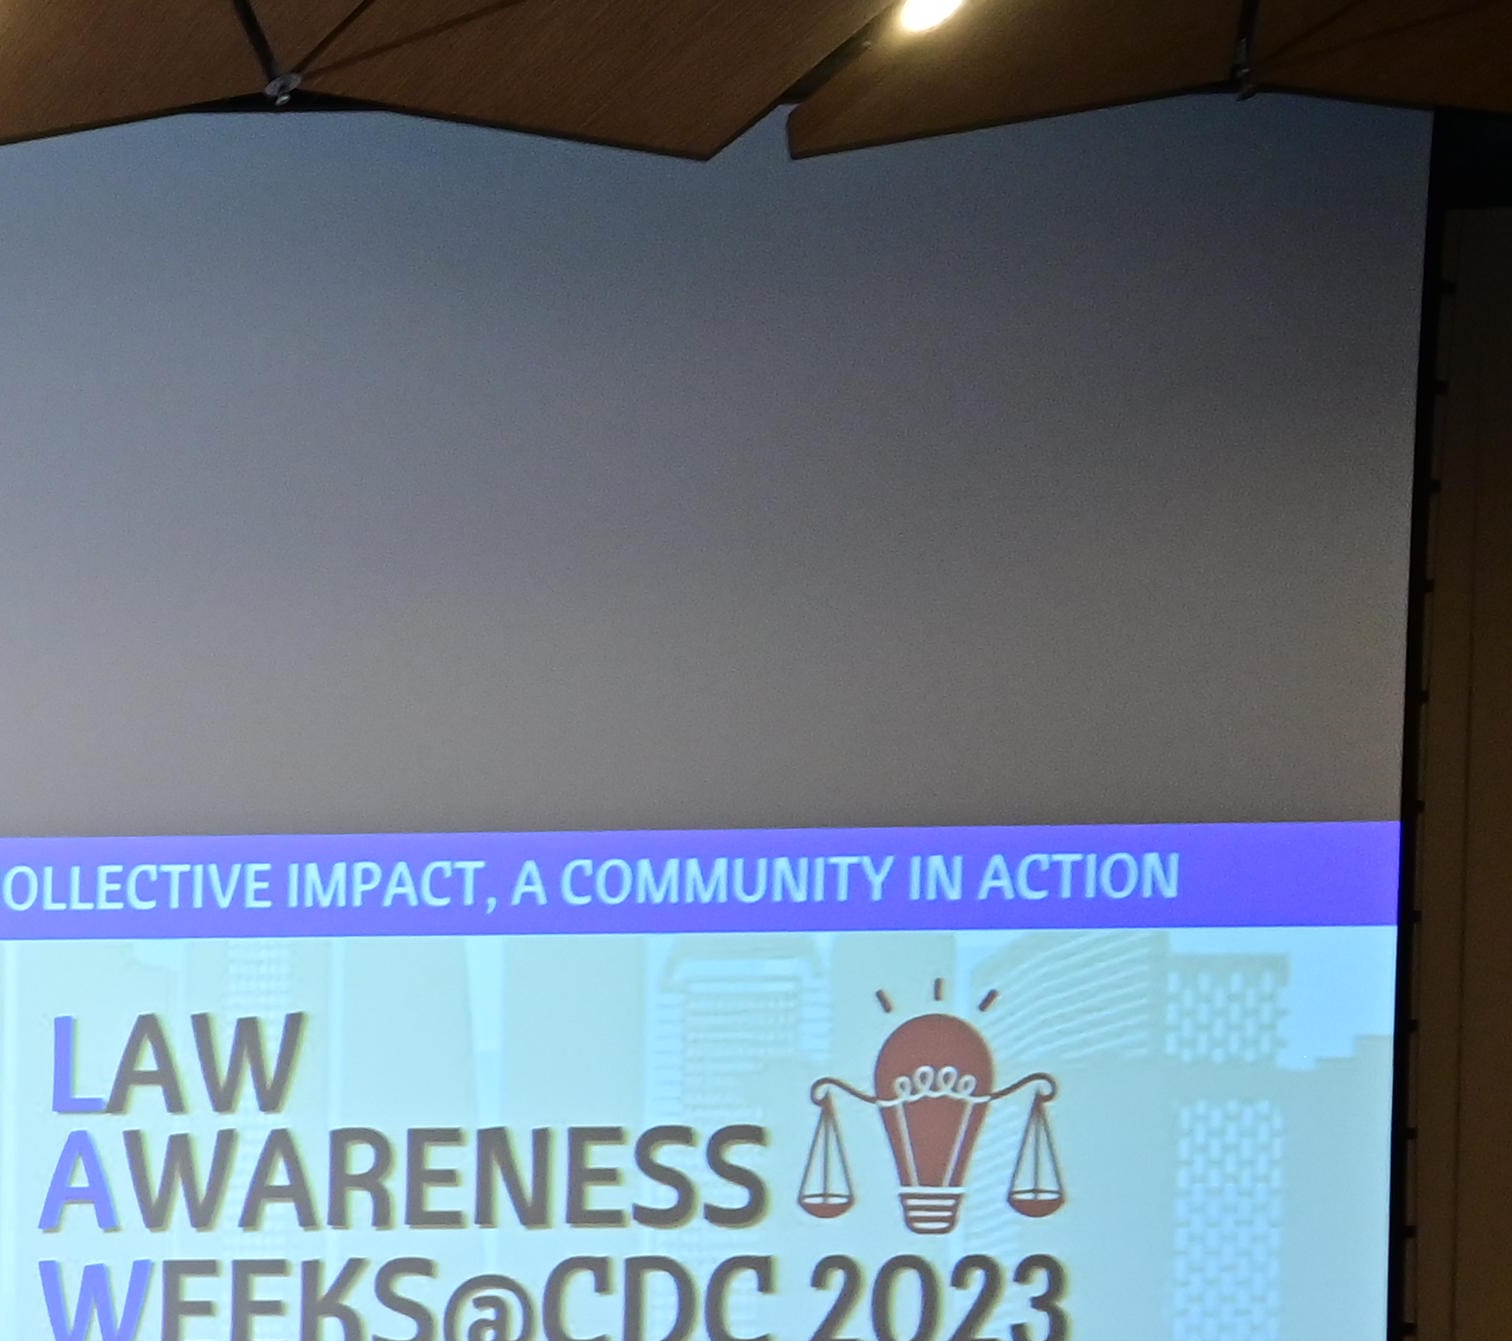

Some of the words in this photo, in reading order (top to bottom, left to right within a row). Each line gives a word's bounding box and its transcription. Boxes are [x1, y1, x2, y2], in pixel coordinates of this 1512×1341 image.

[288, 860, 497, 914] IMPACT,
[511, 859, 548, 905] A
[562, 855, 894, 904] COMMUNITY
[909, 855, 964, 900] IN
[978, 853, 1180, 900] ACTION
[50, 1010, 309, 1115] LAW
[38, 1124, 771, 1232] AWARENESS
